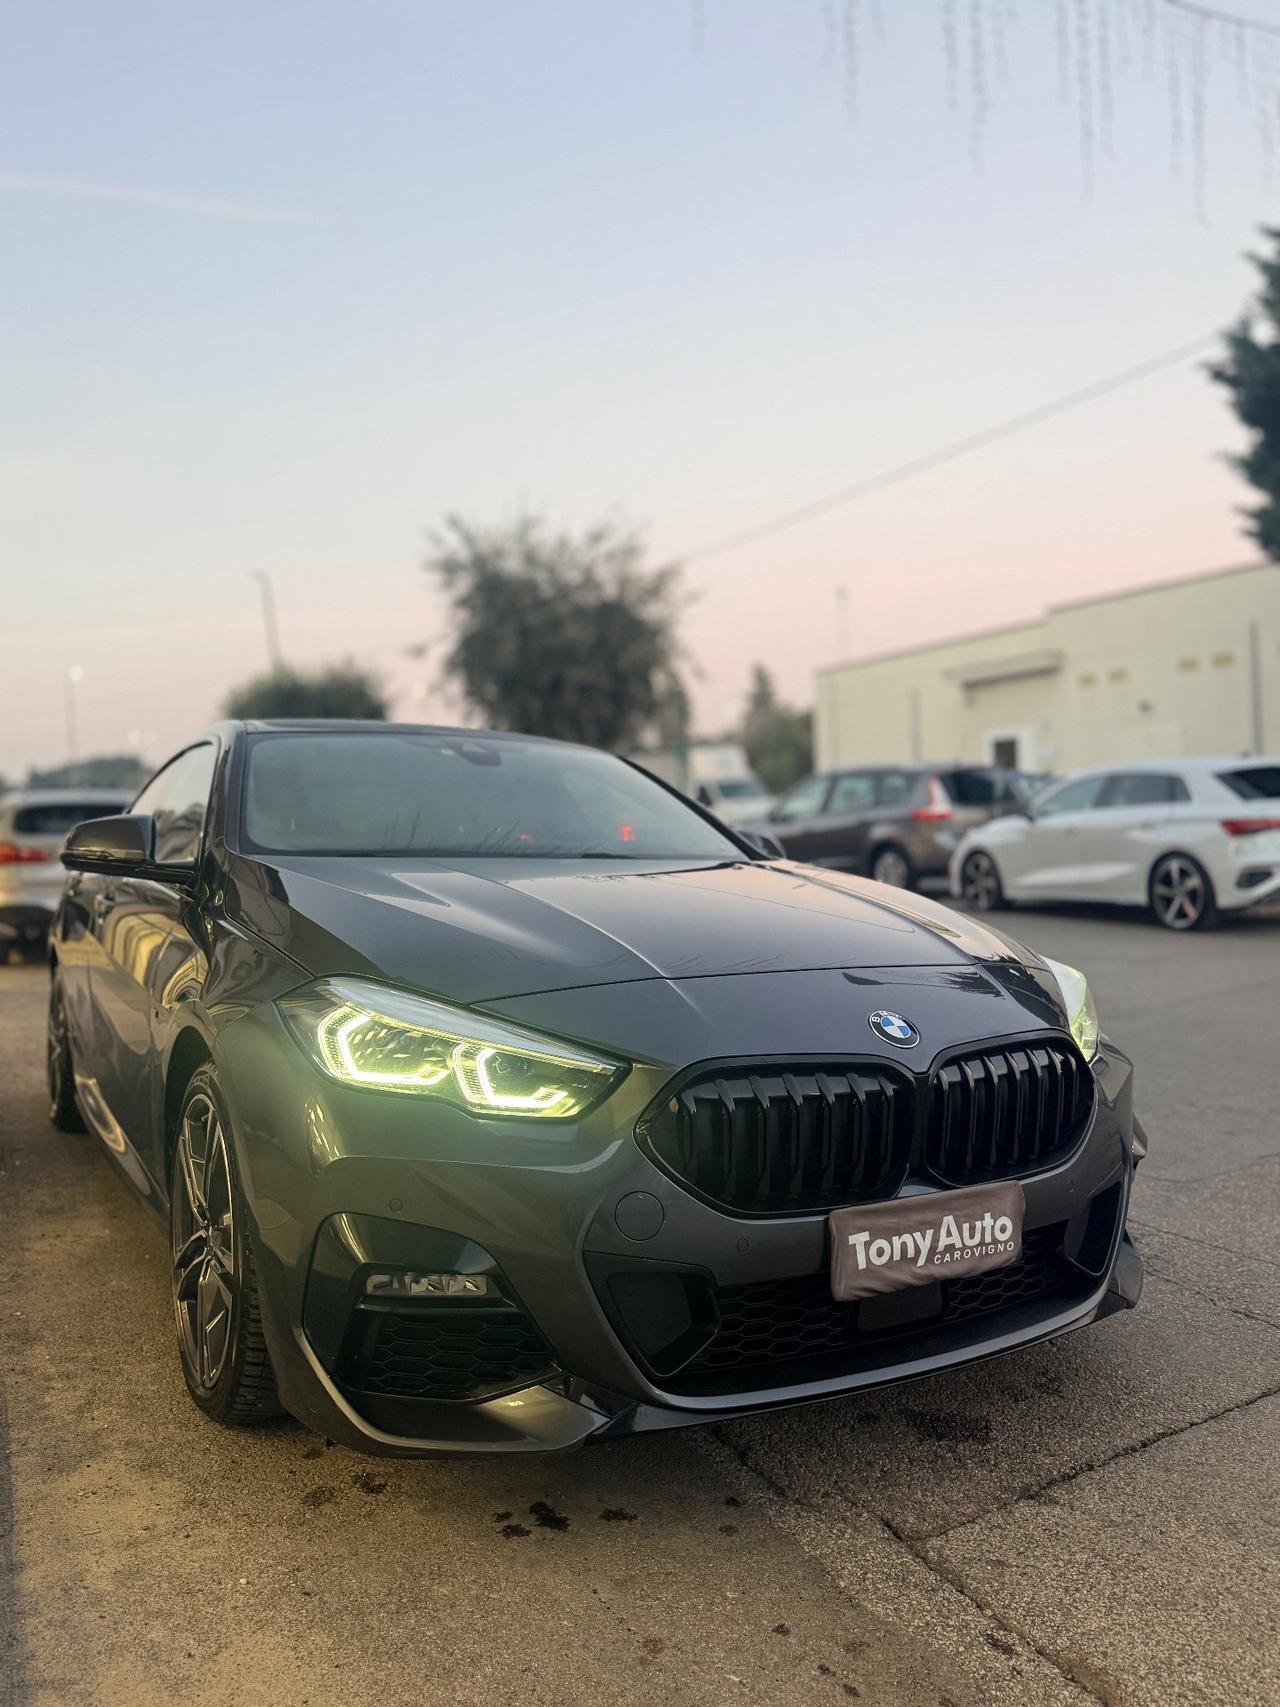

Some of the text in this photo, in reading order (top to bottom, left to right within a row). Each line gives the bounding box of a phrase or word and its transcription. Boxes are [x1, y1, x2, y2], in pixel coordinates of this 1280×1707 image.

[848, 1212, 1013, 1270] Tony Auto
[933, 1241, 1015, 1265] CAROVIGNO
